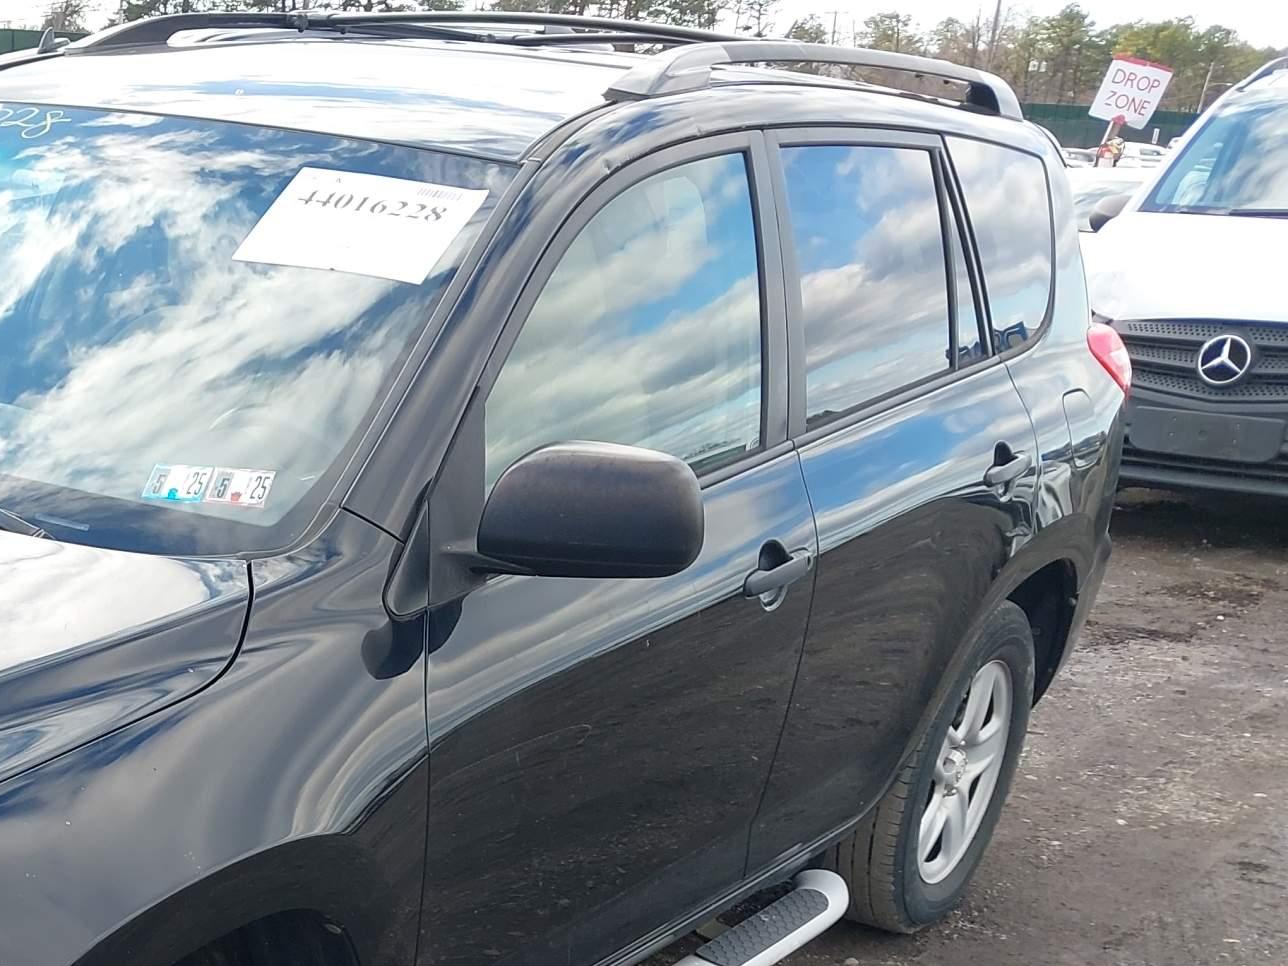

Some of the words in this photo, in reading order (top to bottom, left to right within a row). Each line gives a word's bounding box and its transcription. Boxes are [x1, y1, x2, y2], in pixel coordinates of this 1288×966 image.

[1111, 68, 1161, 94] DROP
[1103, 90, 1151, 117] ZONE
[297, 189, 448, 222] 44016228
[185, 471, 208, 496] 25
[216, 477, 230, 499] 5
[249, 475, 271, 501] 25
